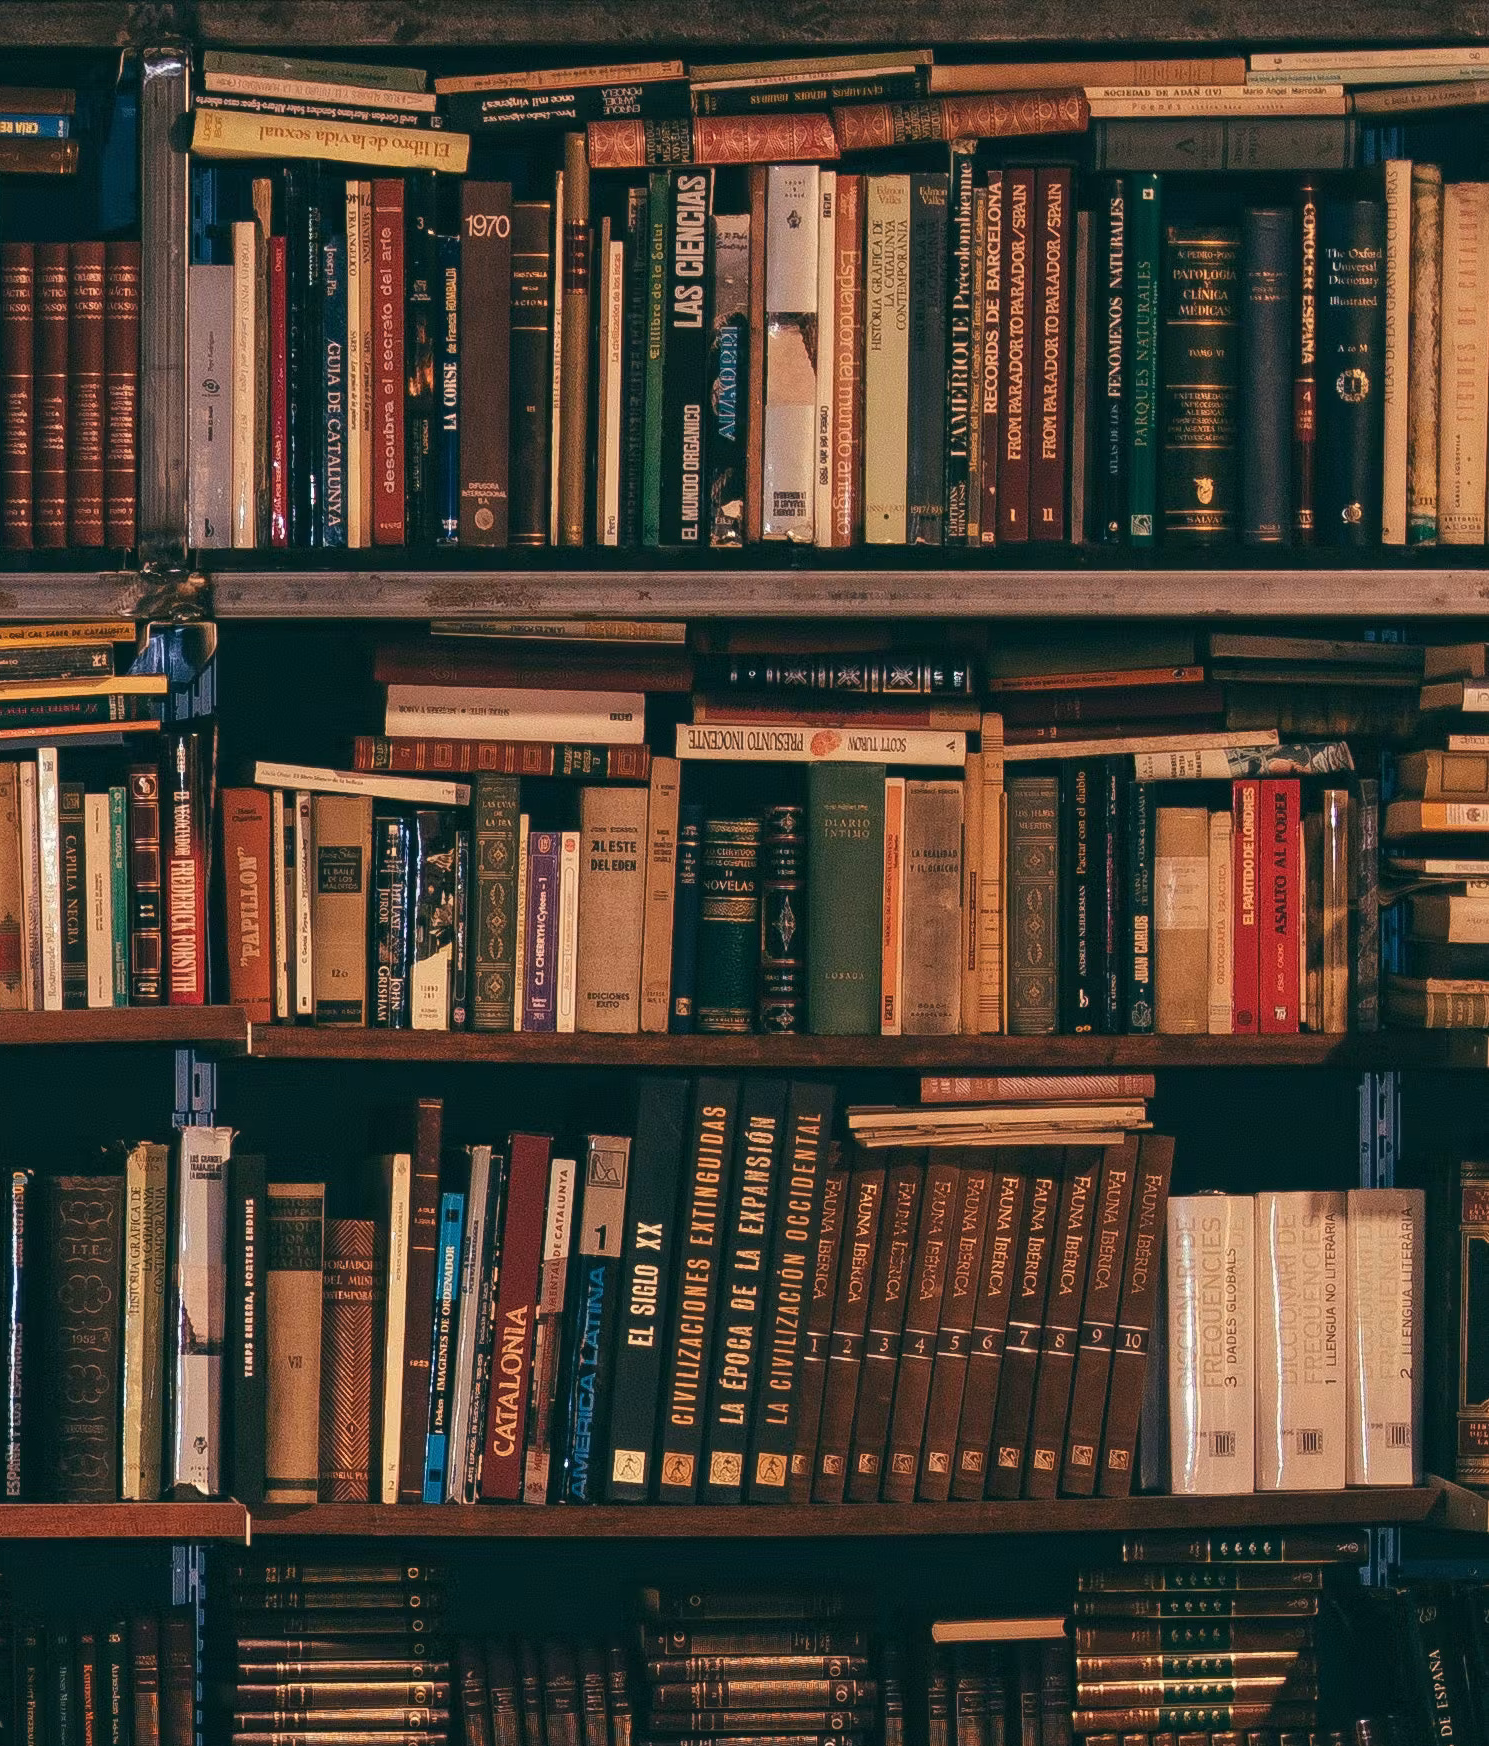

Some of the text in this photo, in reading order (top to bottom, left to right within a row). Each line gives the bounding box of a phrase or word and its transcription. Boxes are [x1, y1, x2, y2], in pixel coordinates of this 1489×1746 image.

[464, 214, 511, 239] 1970
[674, 175, 707, 327] LAS CIENCIAS
[1108, 198, 1123, 289] NATURALES
[1325, 247, 1383, 259] The Oxford
[1328, 261, 1377, 272] Universal
[985, 181, 1002, 414] RECORDS DE BARCELONA
[1009, 317, 1024, 335] TO
[1328, 275, 1381, 288] Dictionary
[328, 391, 341, 414] DE
[1008, 337, 1023, 414] PARADOR
[328, 418, 341, 527] CATALUNYA
[1008, 416, 1022, 460] FROM
[681, 523, 698, 540] EL
[682, 474, 699, 521] MUNDO
[689, 730, 907, 752] SCOTT TUROW PRESUNTO INOCENTE
[65, 835, 79, 945] CAPILLA NEGRA
[171, 860, 194, 993] FREDERICK FORSYTH
[244, 1199, 253, 1241] ENDINS
[672, 1104, 728, 1425] CIVILIZACIONES EXTINGUIDAS
[982, 1176, 1017, 1350] FAUNA IBÉRICA 6
[1055, 1175, 1088, 1348] FAUNA IBÉRICA 8
[244, 1245, 253, 1287] PORTES
[628, 1222, 663, 1347] EL SIGLO XX
[719, 1115, 775, 1425] LA ÉPOCA DE LA EXPANSIÓN
[764, 1112, 821, 1426] LA CIVILIZACIÓN OCCIDENTAL
[1322, 1213, 1337, 1367] LLENGUA NO LITERÀRIA
[244, 1343, 253, 1377] TEMPS
[582, 1266, 606, 1365] LATINA
[1224, 1249, 1237, 1388] 3 DADES GLOBALS
[494, 1306, 528, 1457] CATALONIA
[1440, 1714, 1453, 1738] DE
